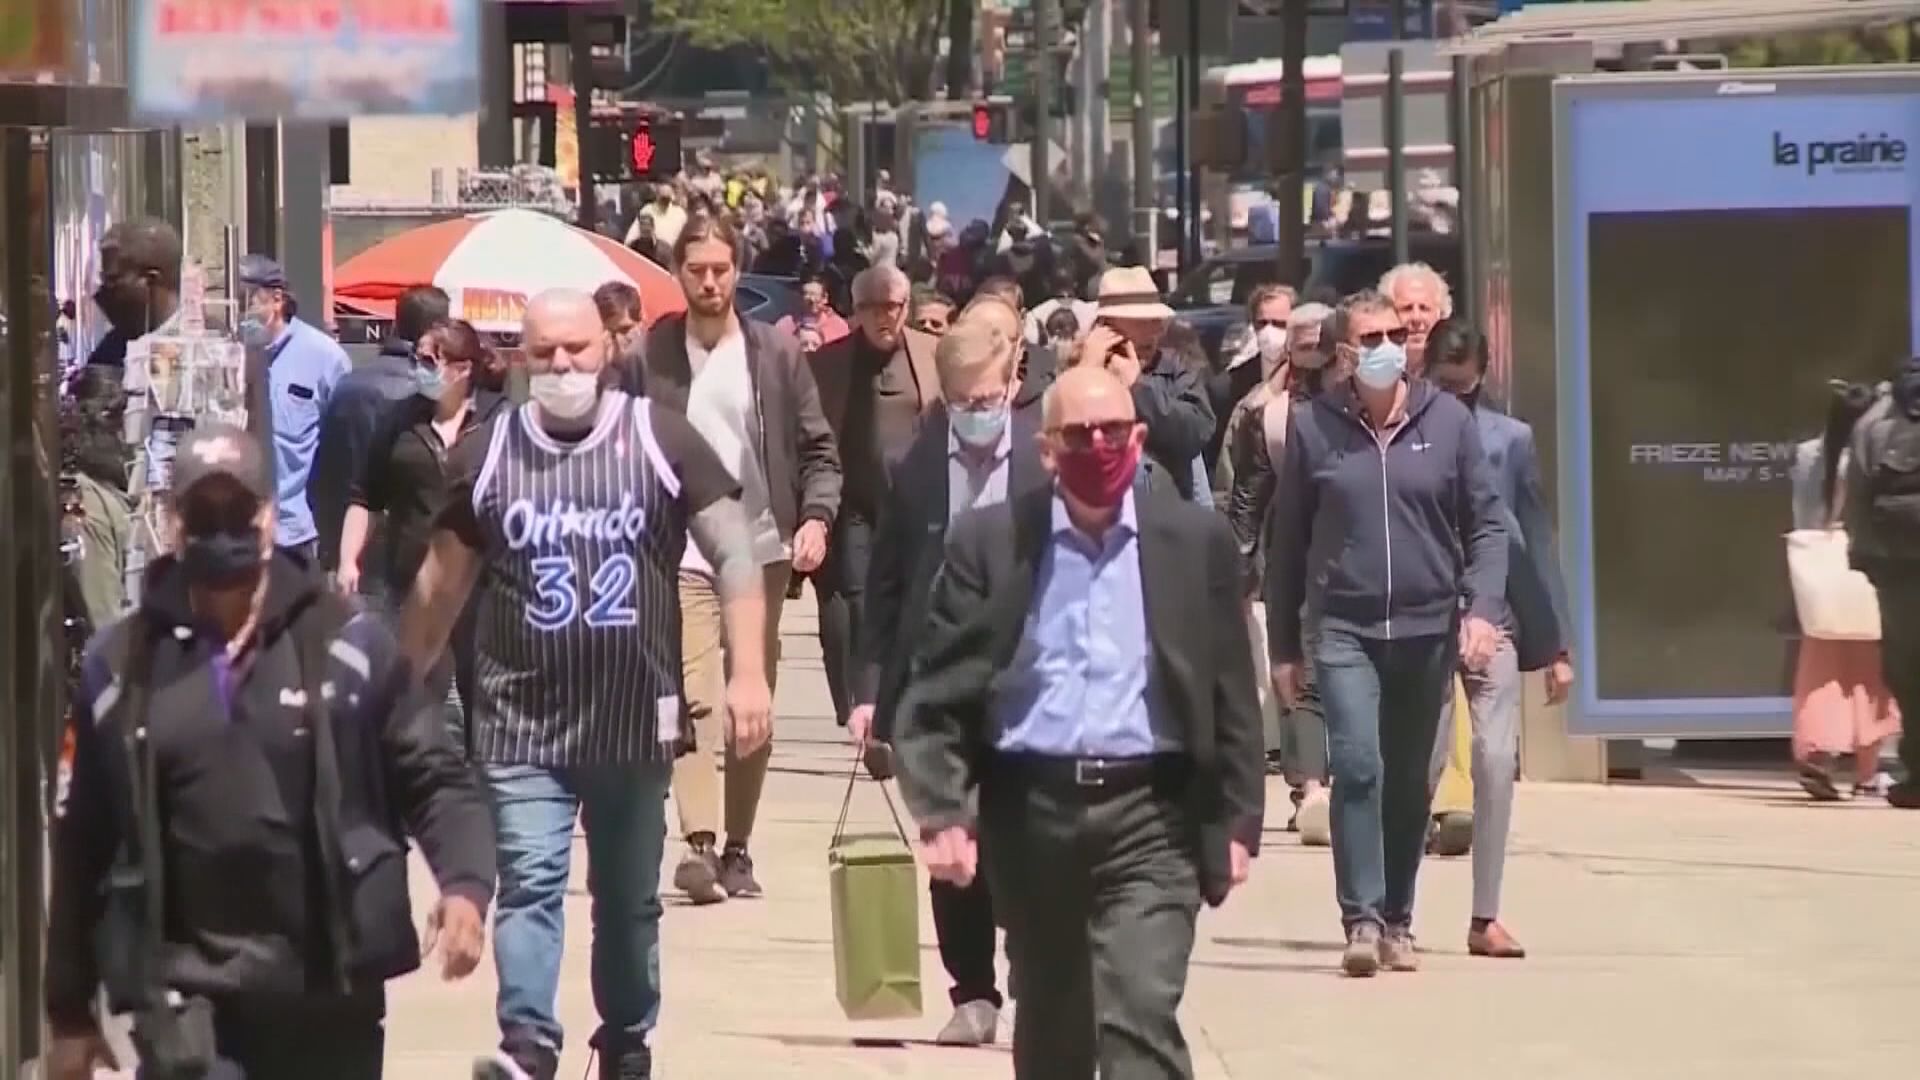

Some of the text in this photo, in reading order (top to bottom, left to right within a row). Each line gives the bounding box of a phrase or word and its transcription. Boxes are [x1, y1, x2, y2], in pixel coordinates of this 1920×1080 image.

[1773, 131, 1906, 175] la prairie
[1630, 442, 1789, 464] FRIEZE NEW
[1703, 466, 1752, 482] MAY
[525, 553, 637, 630] 32
